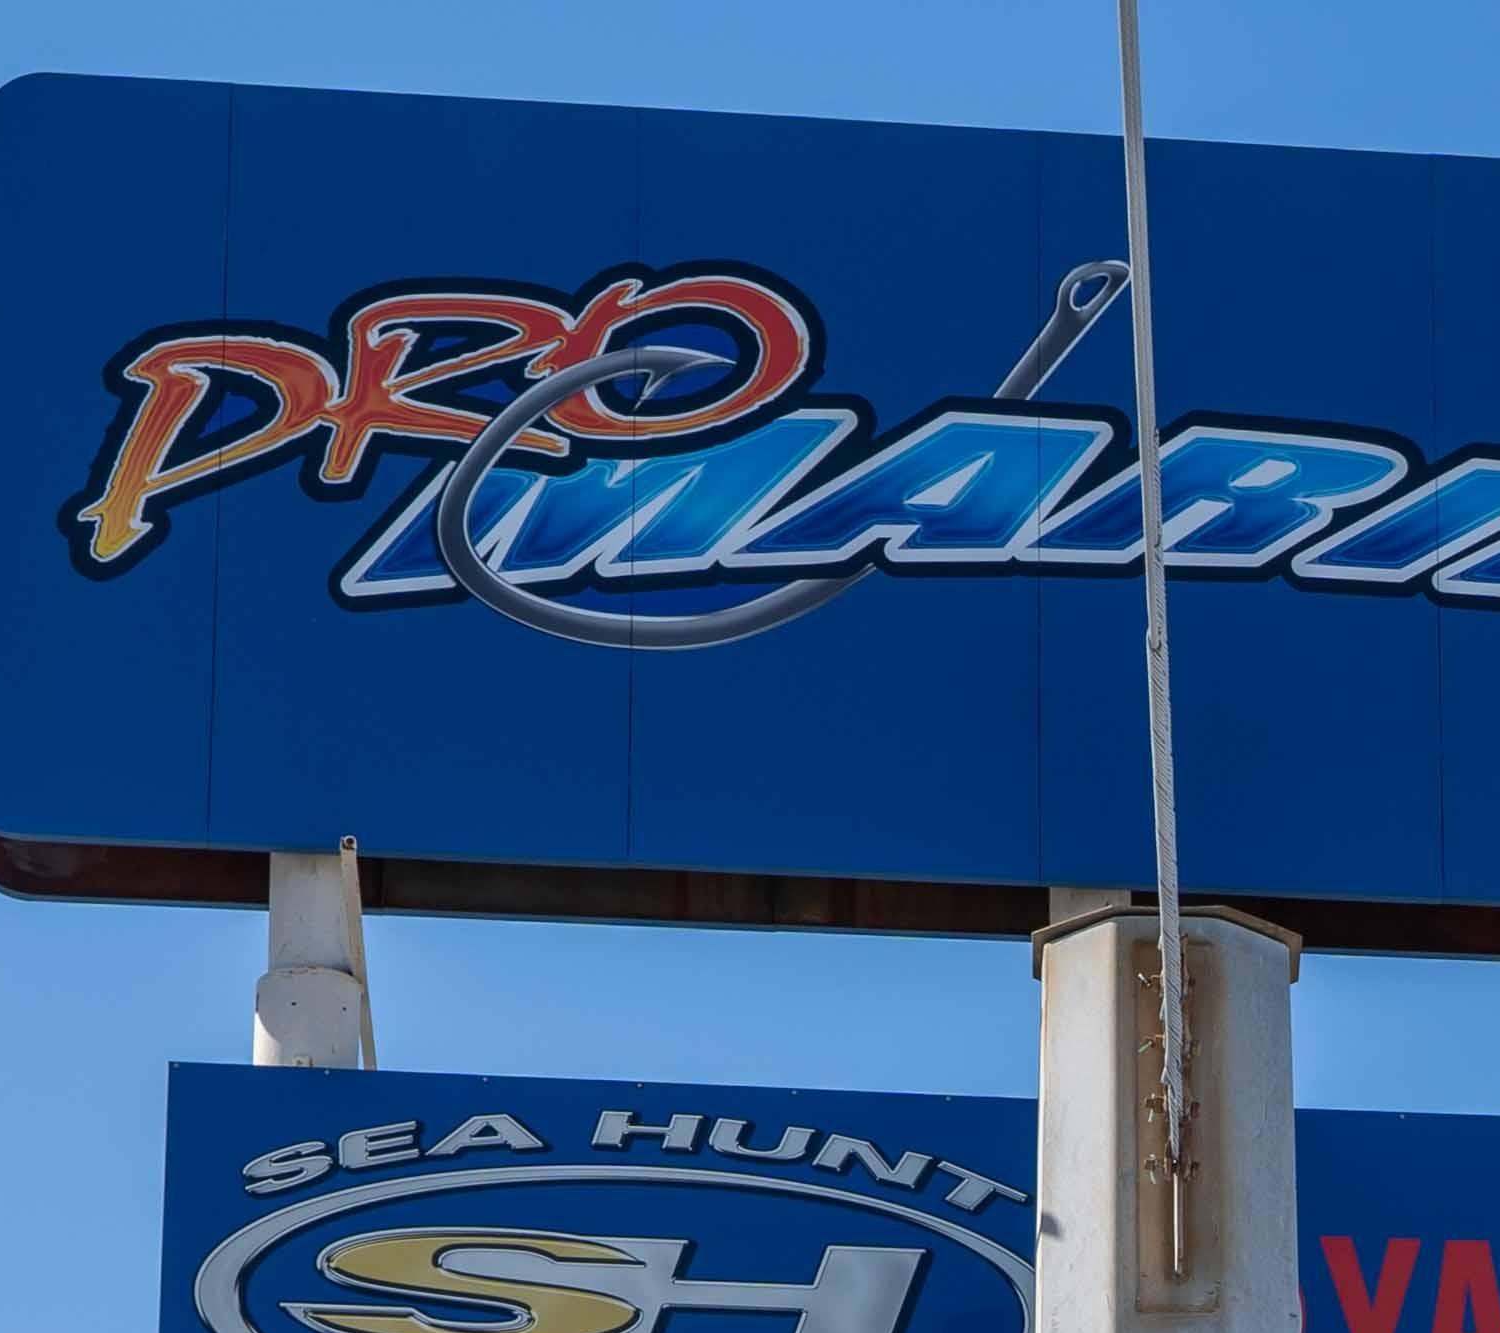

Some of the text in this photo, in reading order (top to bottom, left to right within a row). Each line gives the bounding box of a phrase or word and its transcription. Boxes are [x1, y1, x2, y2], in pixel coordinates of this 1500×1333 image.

[74, 270, 815, 565] PRO
[242, 1110, 1030, 1211] SEA HUNT
